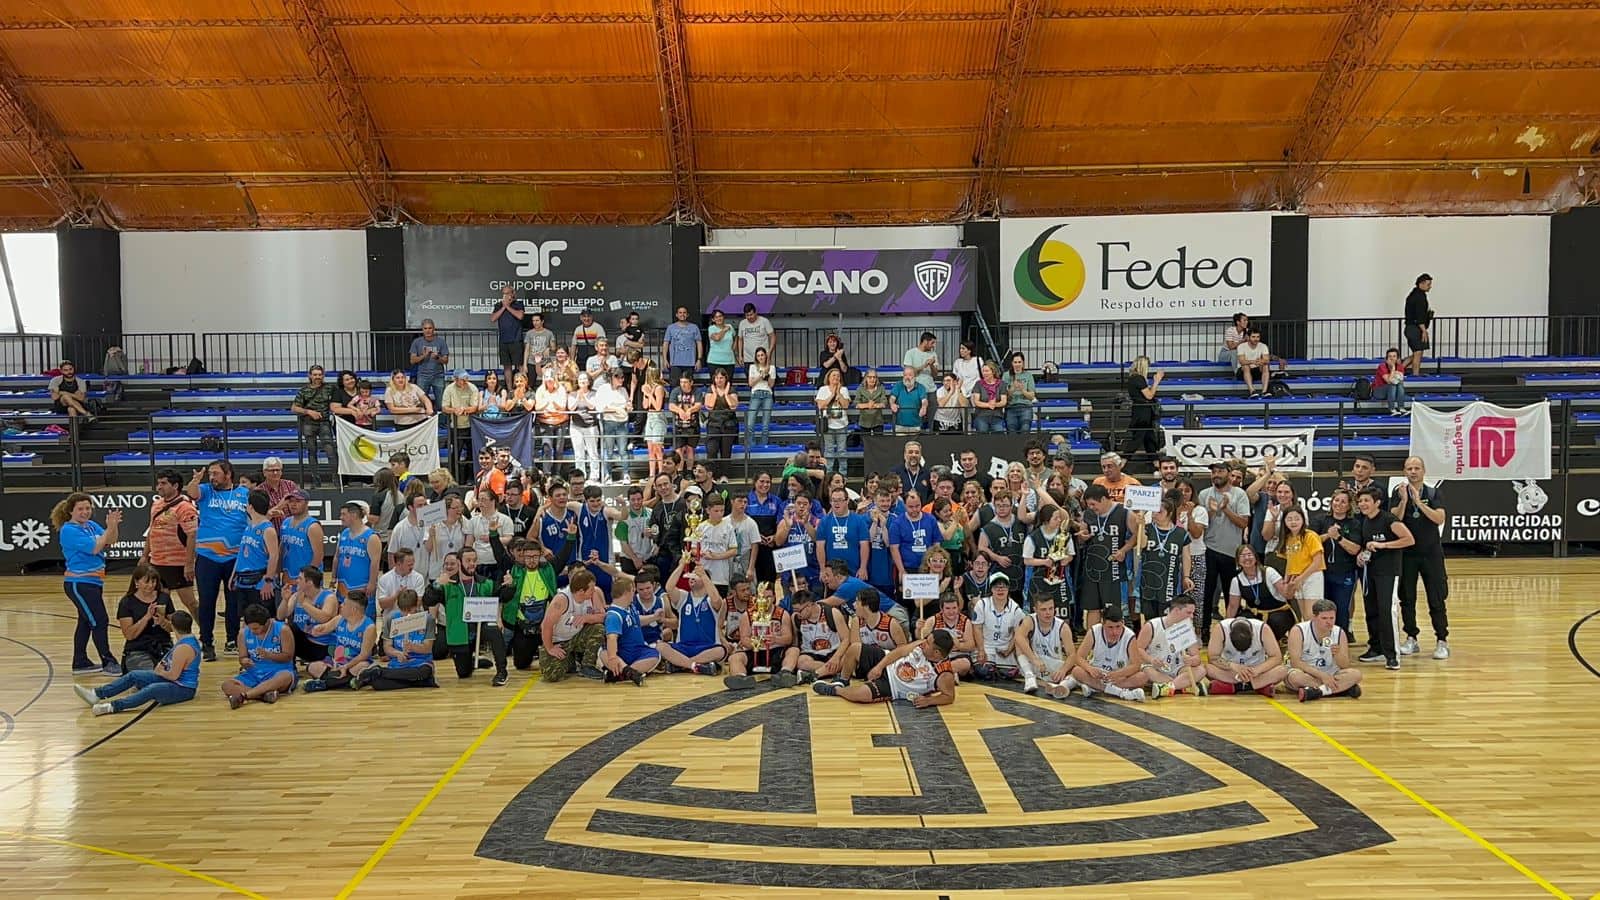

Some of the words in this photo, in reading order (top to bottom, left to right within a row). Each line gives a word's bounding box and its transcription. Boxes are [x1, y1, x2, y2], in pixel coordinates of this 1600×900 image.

[1096, 241, 1253, 291] Fedea
[730, 270, 888, 295] DECANO
[562, 298, 605, 307] FILEPPO
[1101, 298, 1164, 313] Respaldo
[1169, 300, 1186, 308] en
[1191, 298, 1206, 308] su
[1212, 295, 1253, 307] tierra
[1180, 444, 1299, 459] CARDON
[1453, 425, 1465, 475] segunda
[583, 516, 589, 527] 4
[1451, 515, 1562, 528] ELECTRICIDAD
[546, 523, 558, 536] 15
[1451, 528, 1562, 541] ILUMINACION
[684, 604, 692, 615] 9
